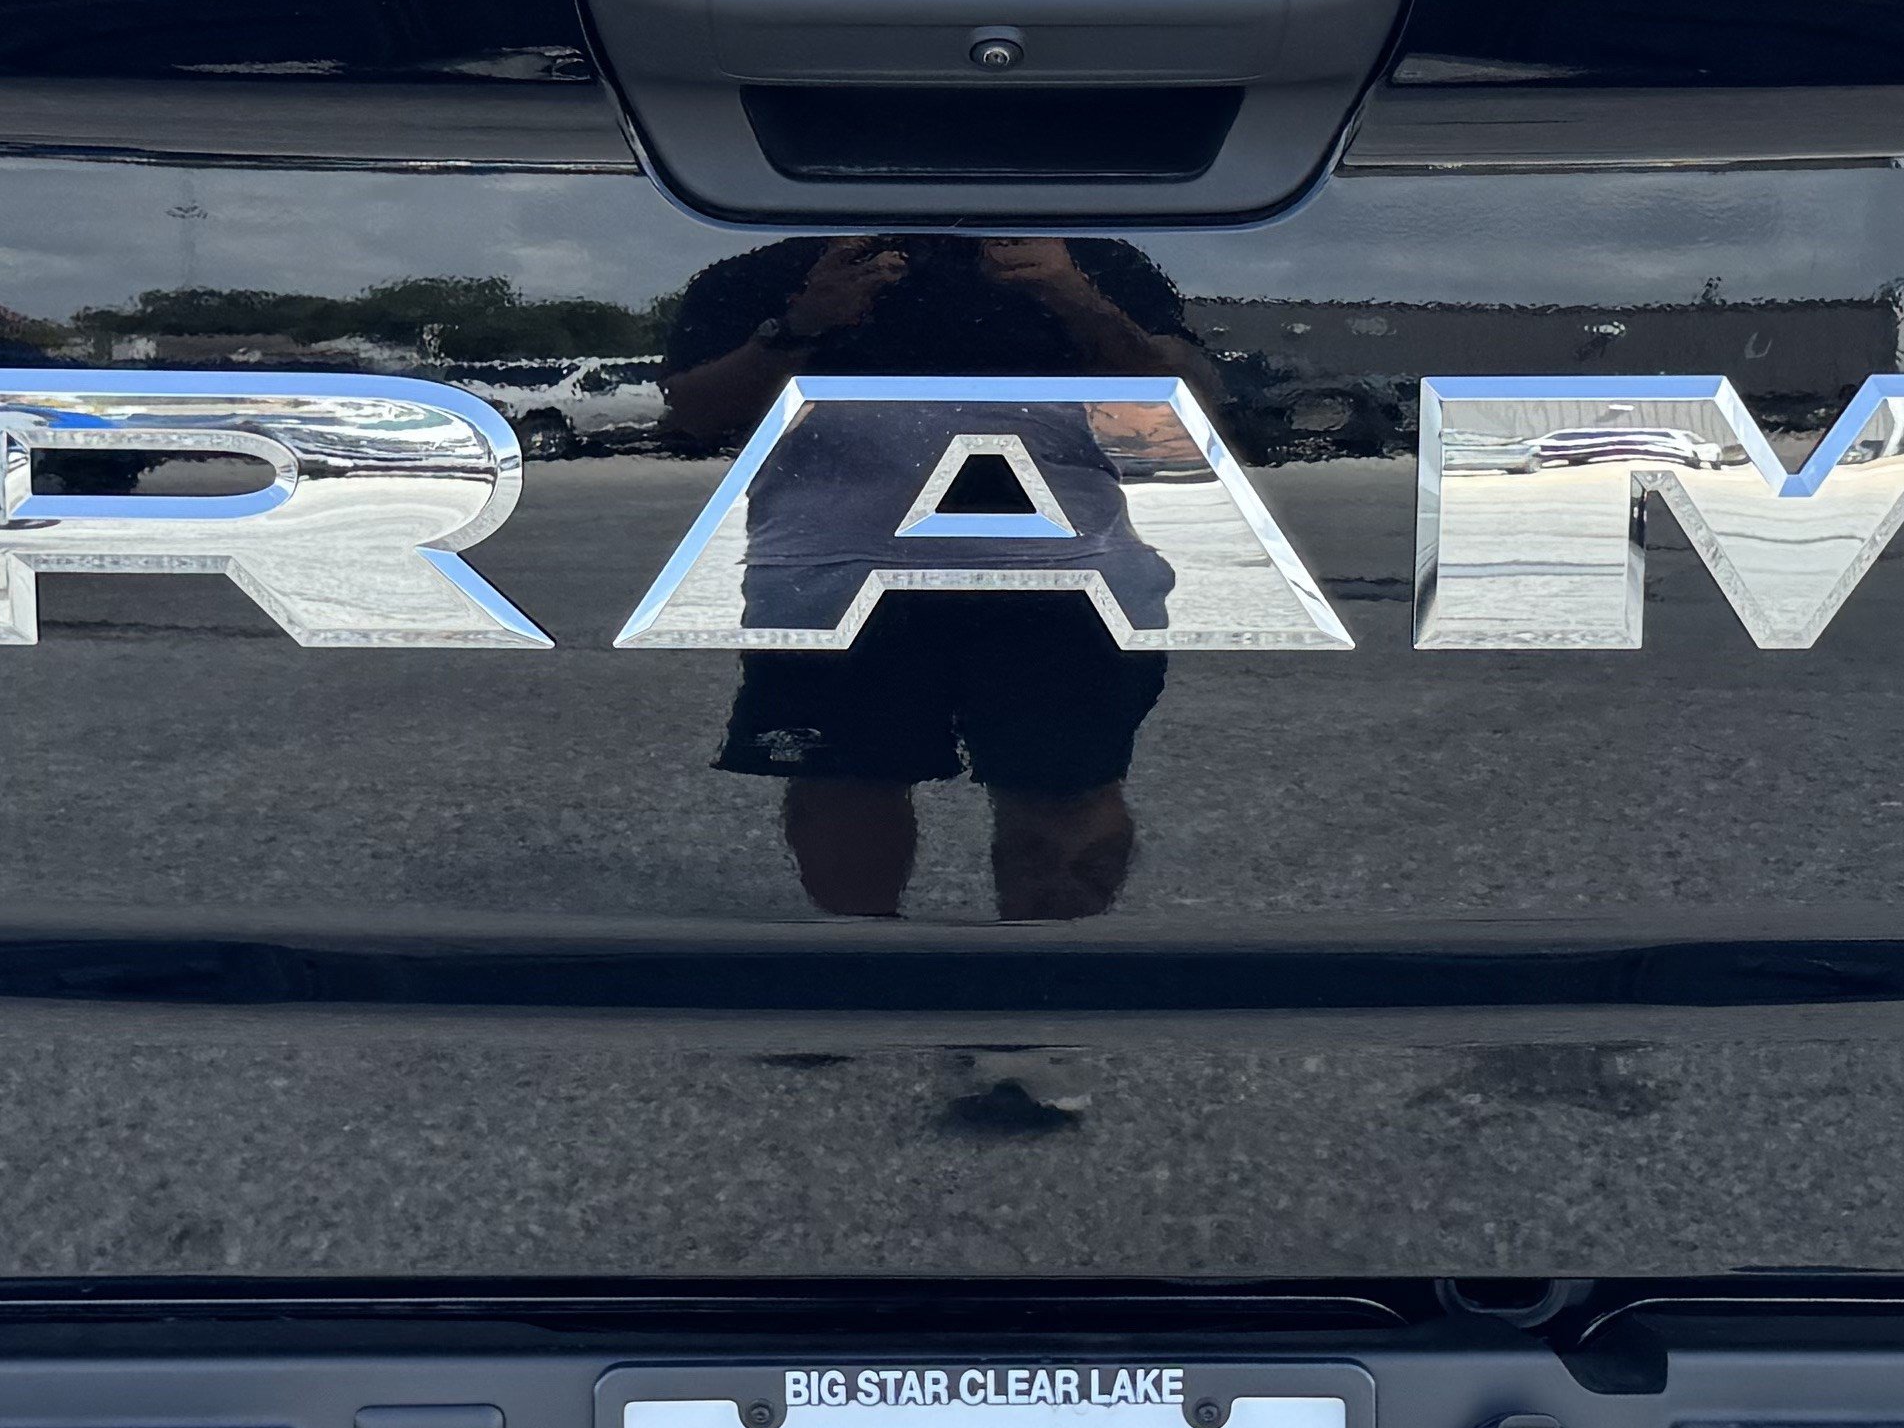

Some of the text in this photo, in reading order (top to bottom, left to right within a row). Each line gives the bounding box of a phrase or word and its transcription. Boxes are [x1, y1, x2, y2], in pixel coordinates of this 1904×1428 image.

[784, 1368, 1185, 1407] BIG STAR CLEAR LAKE
